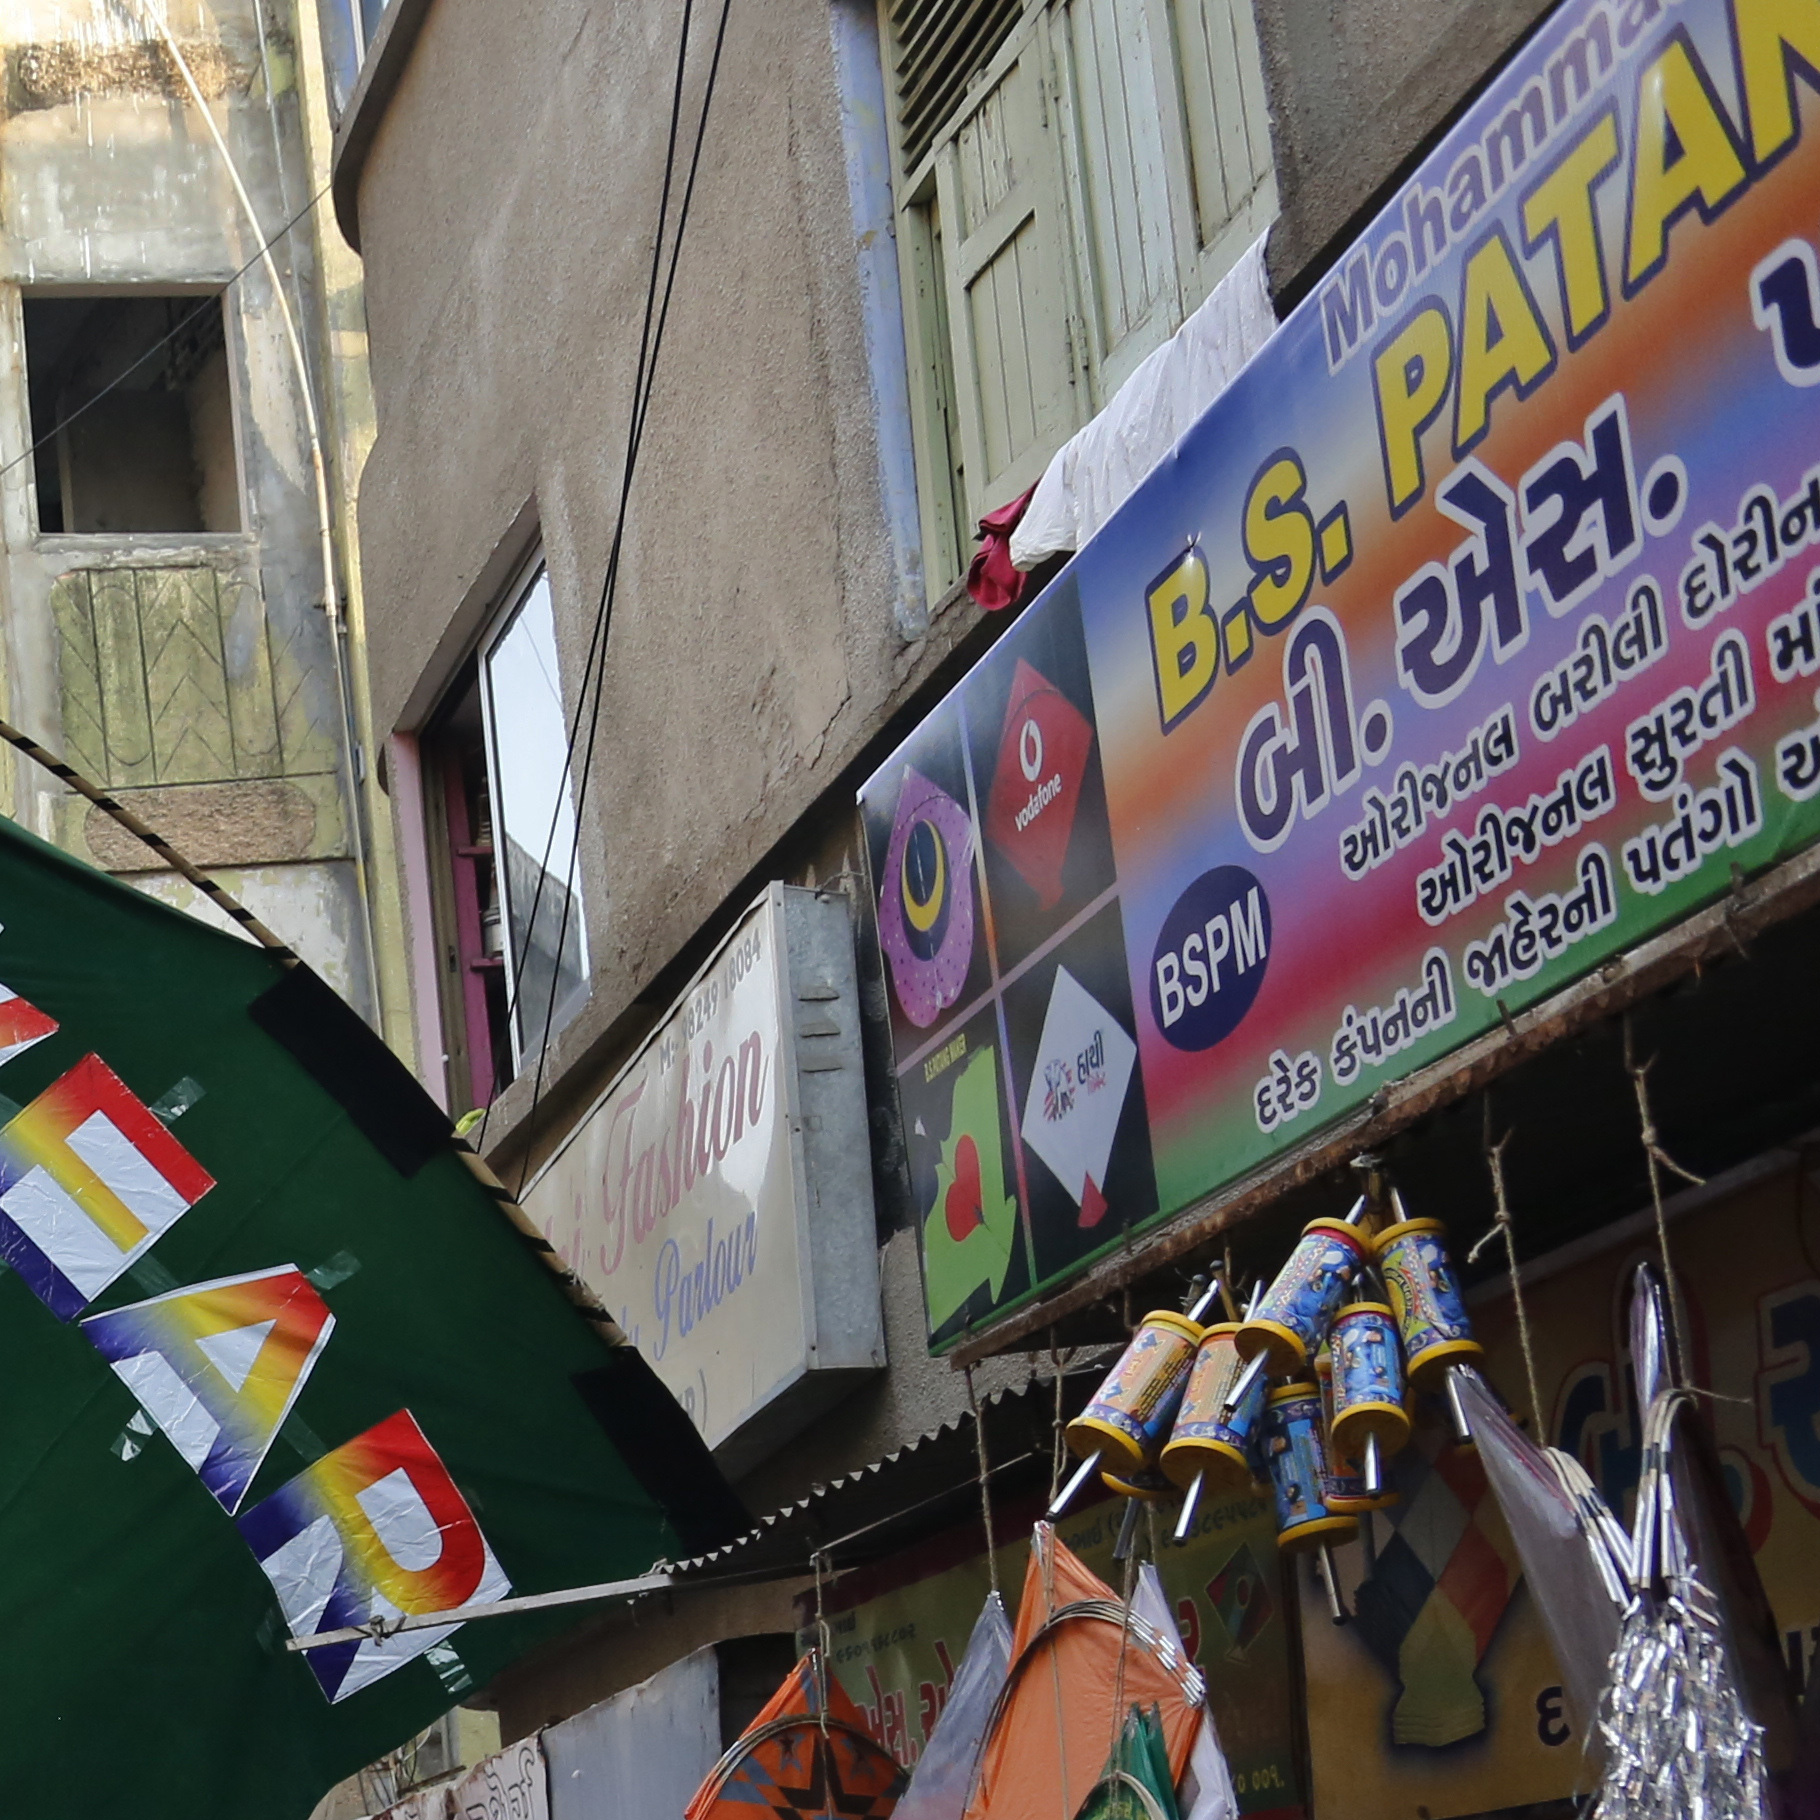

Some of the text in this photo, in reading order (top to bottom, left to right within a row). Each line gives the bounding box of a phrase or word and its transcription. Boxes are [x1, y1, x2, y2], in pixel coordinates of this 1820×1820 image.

[1144, 446, 1352, 733] B.S.
[1237, 393, 1688, 854] બી. એસ.
[1015, 773, 1062, 832] vodafone
[1340, 702, 1518, 881] ઓરીજનલ
[1417, 745, 1616, 925] ઓરીજનલ
[1627, 627, 1755, 802] સુરતી
[1155, 886, 1267, 1029] BSPM
[1253, 1049, 1321, 1134] દરેક
[1623, 746, 1763, 895] પતંગો
[600, 1028, 771, 1277] Fashion
[1077, 1030, 1104, 1085] હાથી
[654, 1211, 757, 1361] Parlour
